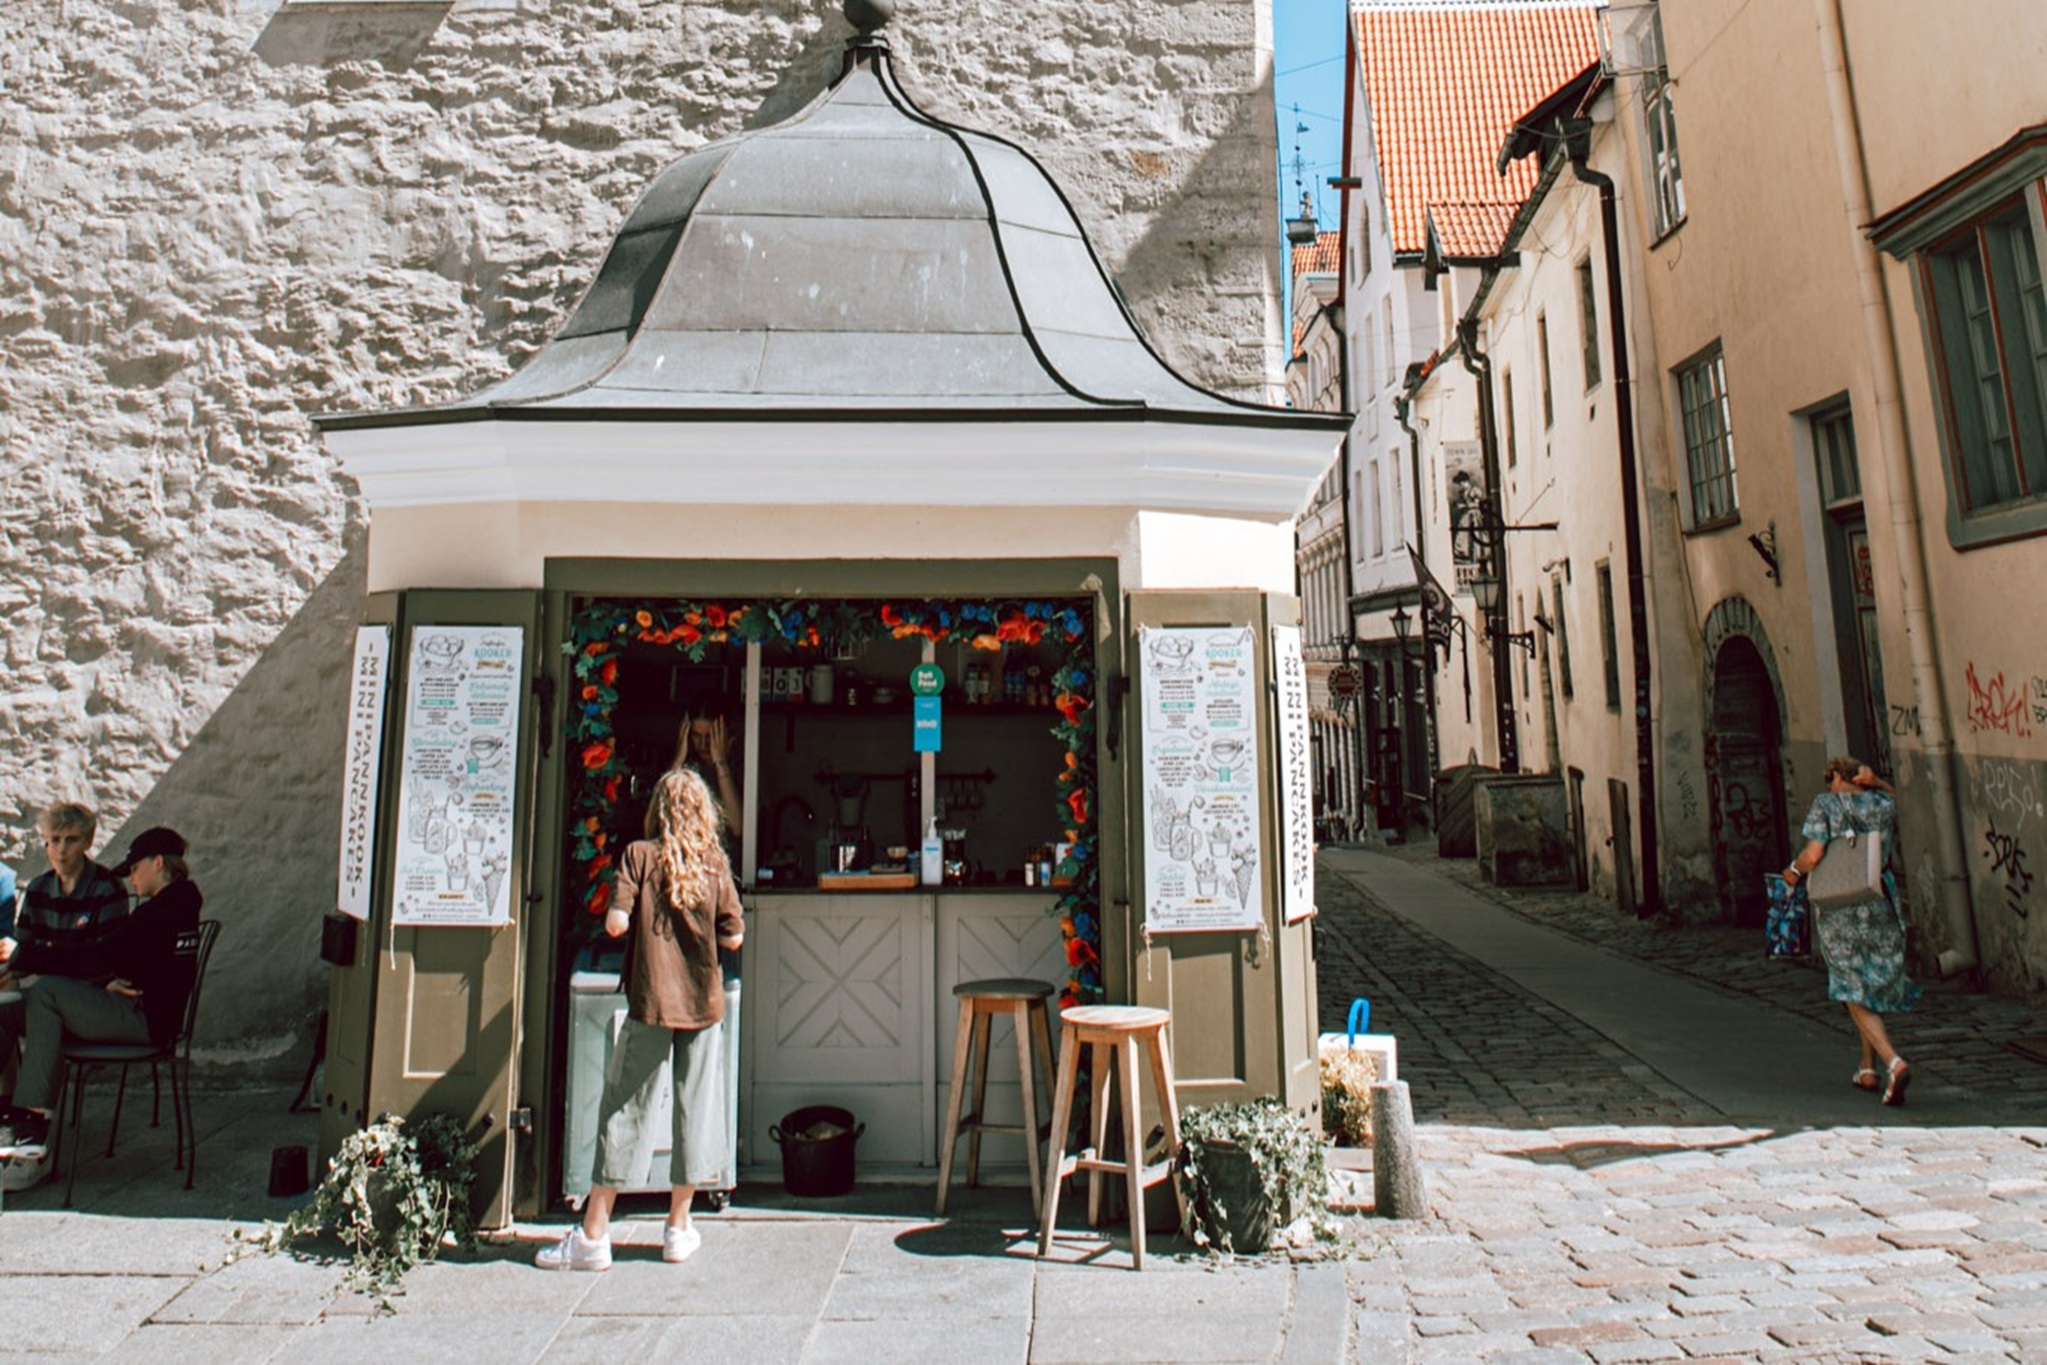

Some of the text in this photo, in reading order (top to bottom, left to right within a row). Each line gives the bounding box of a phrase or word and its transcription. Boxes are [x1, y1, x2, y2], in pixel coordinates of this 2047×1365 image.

[346, 656, 369, 883] MINI PANCAKES
[354, 656, 379, 883] MINIPANNKOOK
[1284, 656, 1301, 886] MINI PANCAKES
